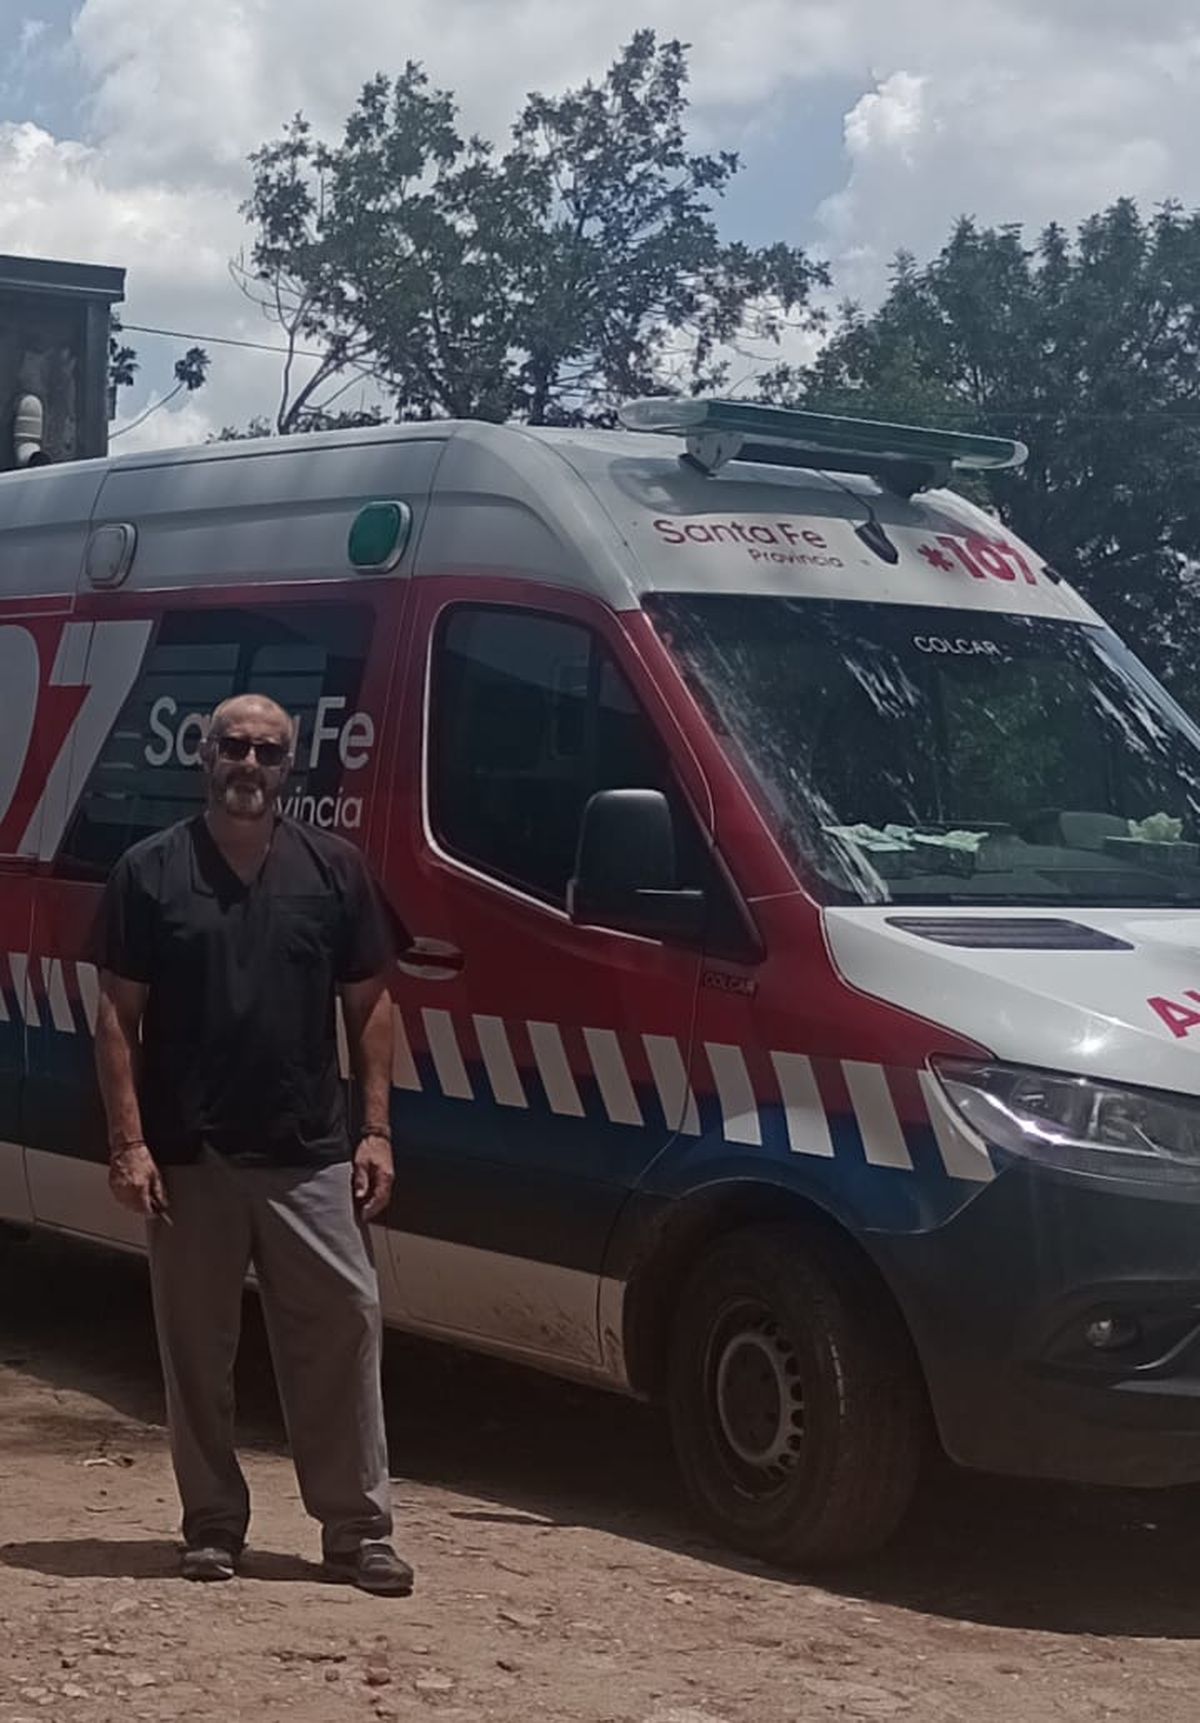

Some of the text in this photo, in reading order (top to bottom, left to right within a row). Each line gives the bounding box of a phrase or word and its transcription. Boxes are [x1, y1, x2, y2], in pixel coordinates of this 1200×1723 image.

[653, 518, 827, 549] Santa Fe
[748, 548, 844, 568] Provincia
[913, 636, 1001, 656] COLCAR
[309, 696, 375, 770] Fe
[276, 786, 364, 829] vincia
